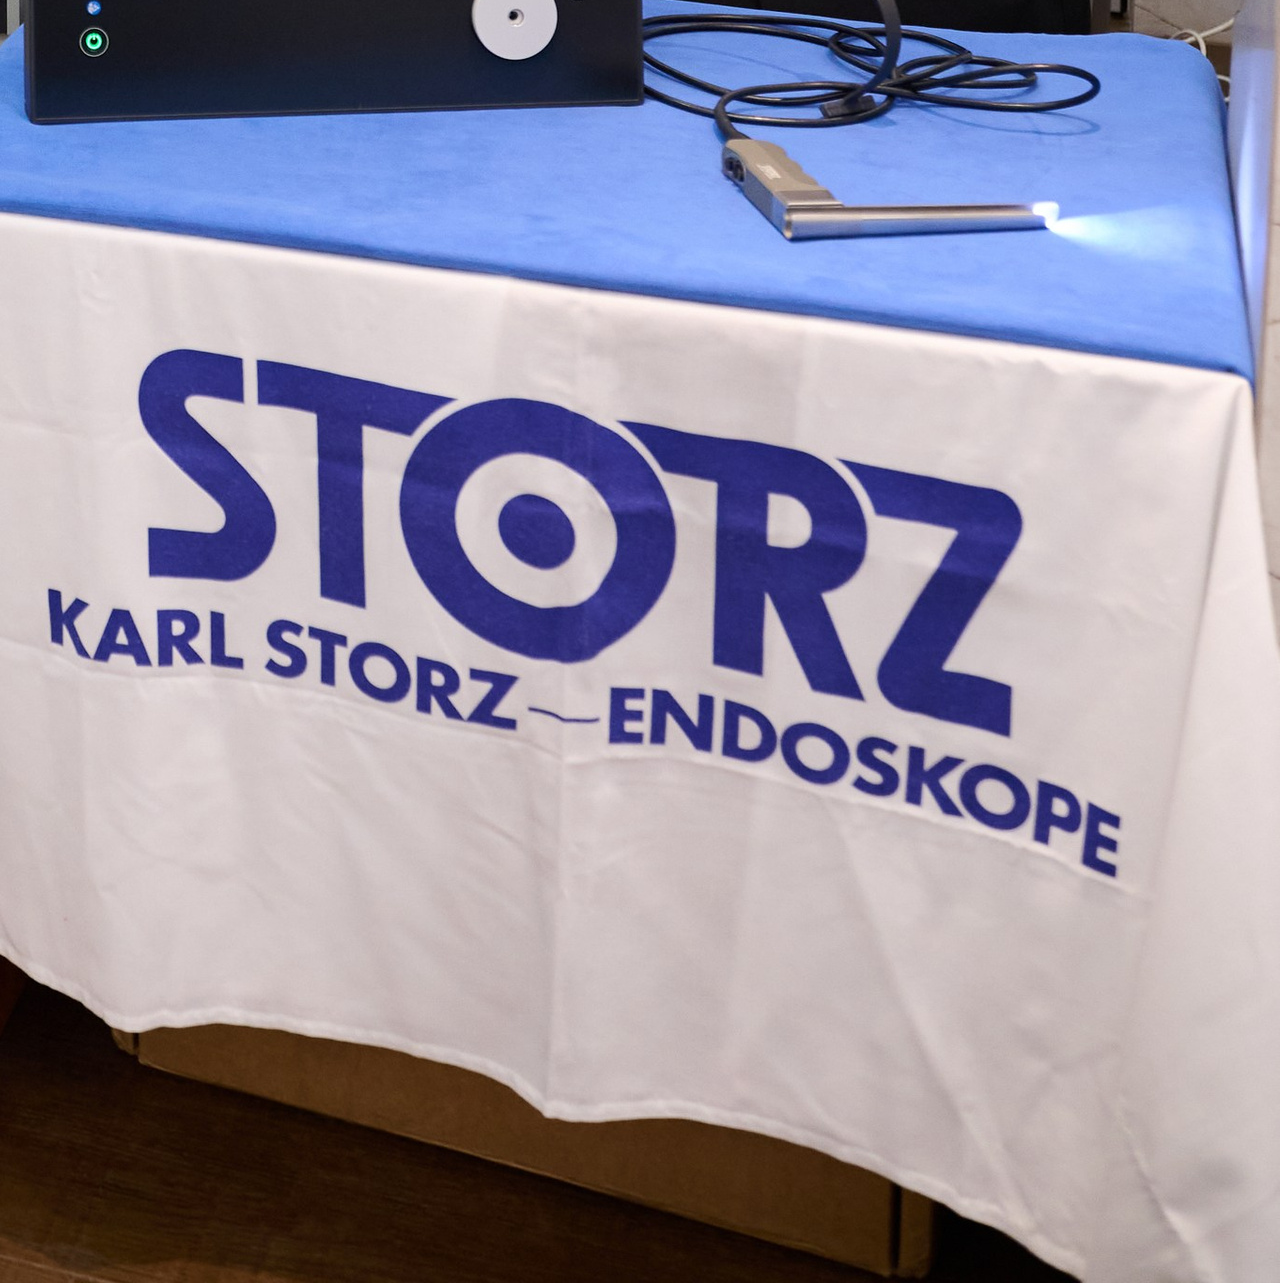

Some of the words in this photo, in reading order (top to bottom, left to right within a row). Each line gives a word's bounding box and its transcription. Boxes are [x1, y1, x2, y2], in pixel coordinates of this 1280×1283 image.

[137, 348, 1024, 739] STORZ
[47, 588, 244, 670] KARL
[264, 618, 520, 732] STORZ
[607, 686, 1122, 879] ENDOSKOPE
